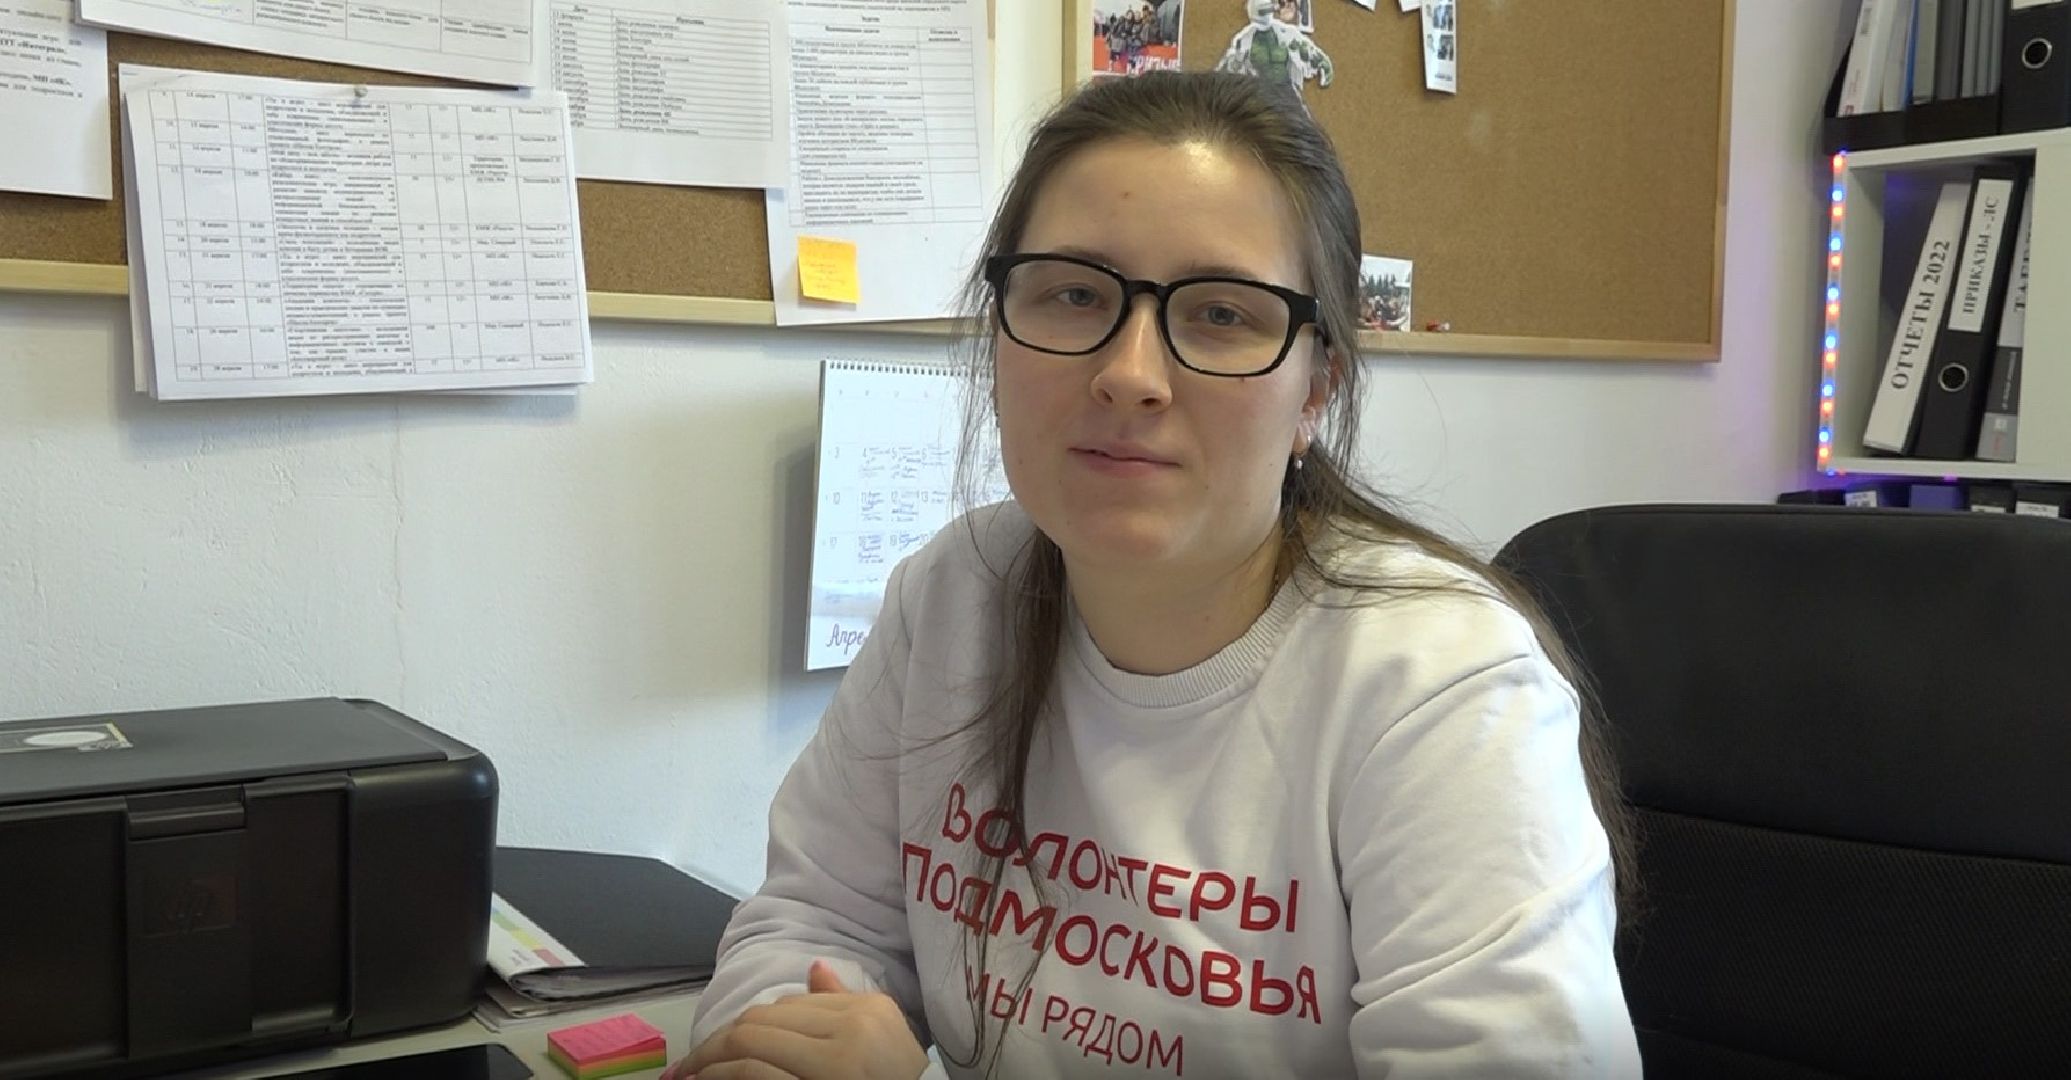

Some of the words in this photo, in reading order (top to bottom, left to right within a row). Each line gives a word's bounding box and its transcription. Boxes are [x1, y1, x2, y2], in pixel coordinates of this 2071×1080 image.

[1891, 291, 1935, 390] ОТЧЕТЫ
[1922, 240, 1950, 286] 2022
[1962, 233, 1991, 314] ПРИКАЗЫ
[1984, 196, 2000, 222] ЛС
[825, 622, 867, 655] Апре
[942, 783, 1299, 932] ВОЛОНТЕРЫ
[902, 842, 1322, 1024] ПОДМОСКОВЬЯ
[966, 965, 1033, 1026] МЫ
[1041, 995, 1184, 1077] РЯДОМ
